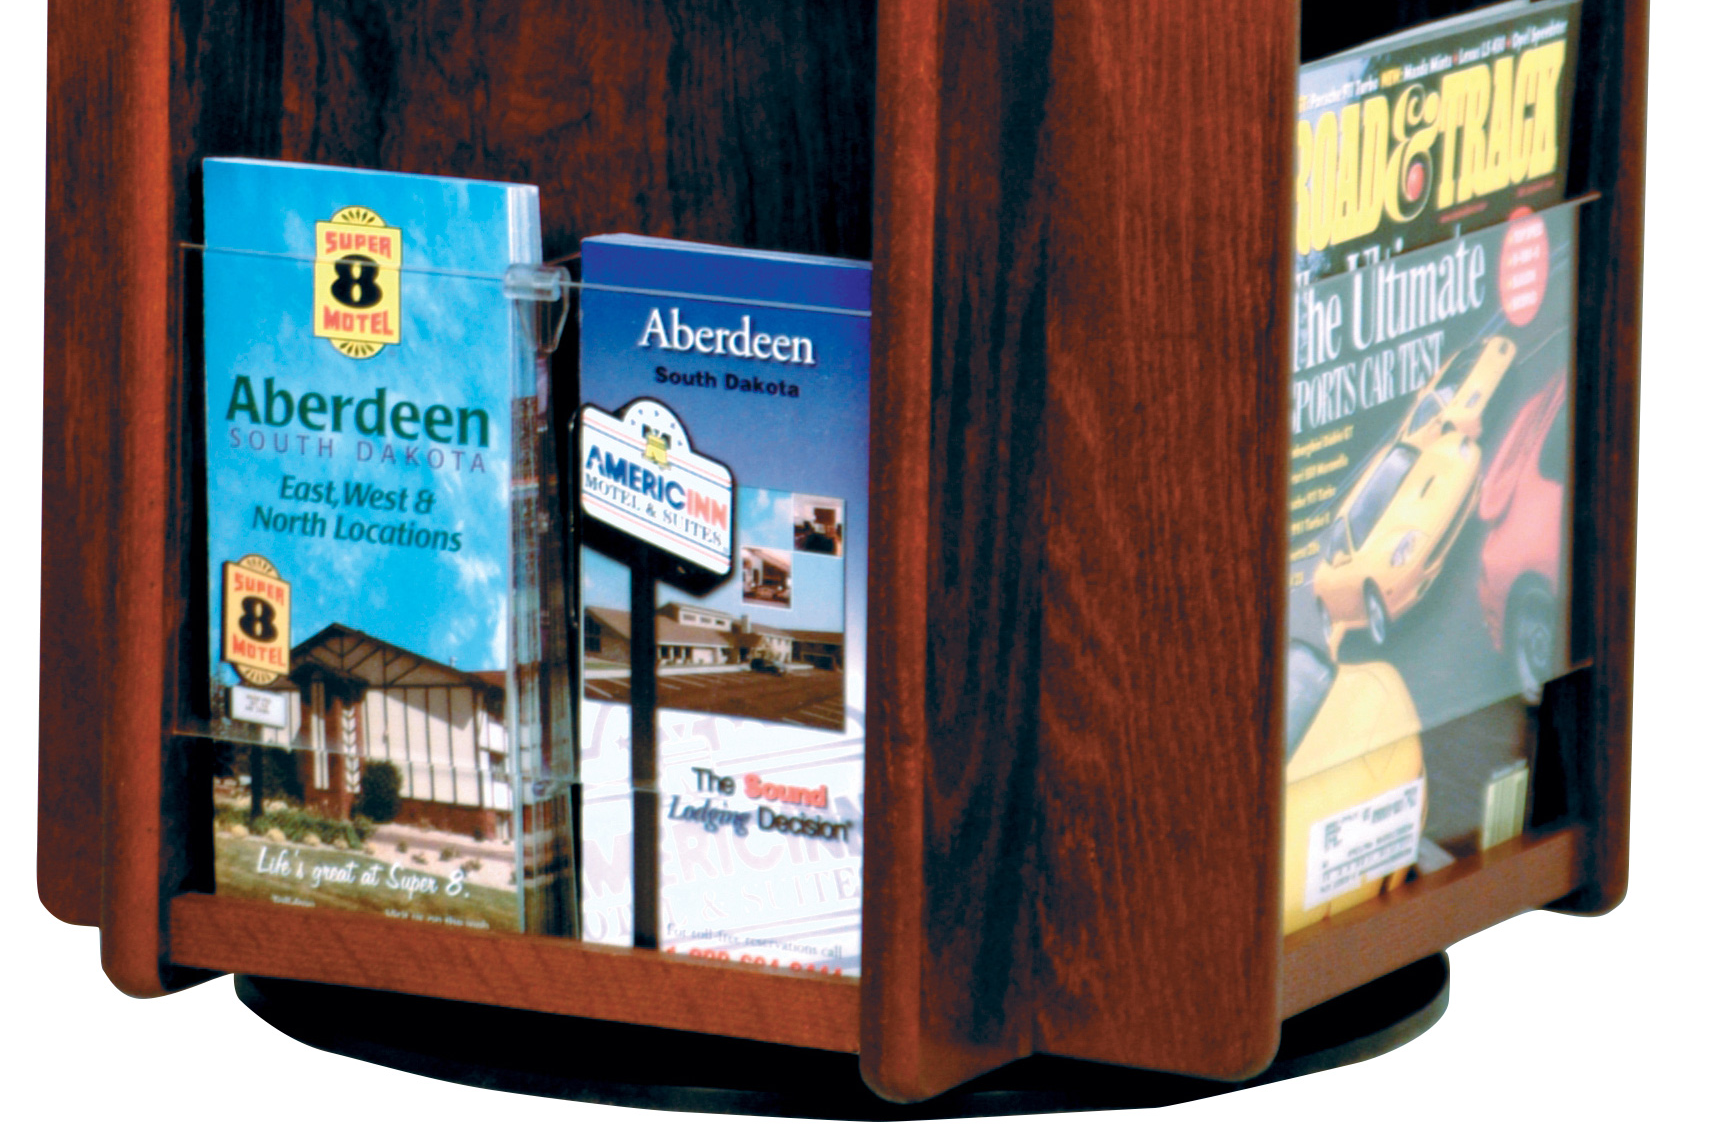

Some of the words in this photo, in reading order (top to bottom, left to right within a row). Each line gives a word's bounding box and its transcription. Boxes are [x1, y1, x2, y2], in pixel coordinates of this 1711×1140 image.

[1296, 95, 1389, 256] ROAD
[1437, 39, 1566, 211] TRACK
[325, 230, 392, 259] SUPER
[330, 253, 383, 309] 8
[1348, 221, 1486, 351] Ultimate
[322, 305, 394, 336] MOTEL
[637, 307, 816, 365] Aberdeen
[655, 366, 717, 388] South
[725, 373, 800, 398] Dakota
[1293, 362, 1356, 435] PORTS
[1359, 349, 1394, 410] CAR
[1399, 330, 1445, 396] TEST
[226, 374, 490, 448] Aberdeen
[229, 427, 334, 458] SOUTH
[357, 440, 487, 474] DAKOTA
[414, 488, 436, 514] &
[585, 444, 728, 531] AMERICINN
[585, 473, 641, 511] MOTEL
[645, 502, 657, 518] &
[663, 509, 722, 546] SUITES
[253, 506, 328, 538] North
[334, 515, 462, 552] Locations
[233, 572, 285, 606] SUPER
[238, 595, 279, 643] 8
[232, 634, 286, 667] MOTEL
[691, 766, 736, 796] The
[743, 772, 828, 809] Sound
[668, 794, 751, 838] Lodging
[256, 846, 305, 880] Life's
[310, 861, 359, 888] great
[360, 864, 384, 887] at
[386, 860, 438, 901] Super
[445, 868, 470, 898] 8.
[667, 923, 686, 938] For
[745, 936, 818, 955] reservations
[821, 944, 843, 960] call
